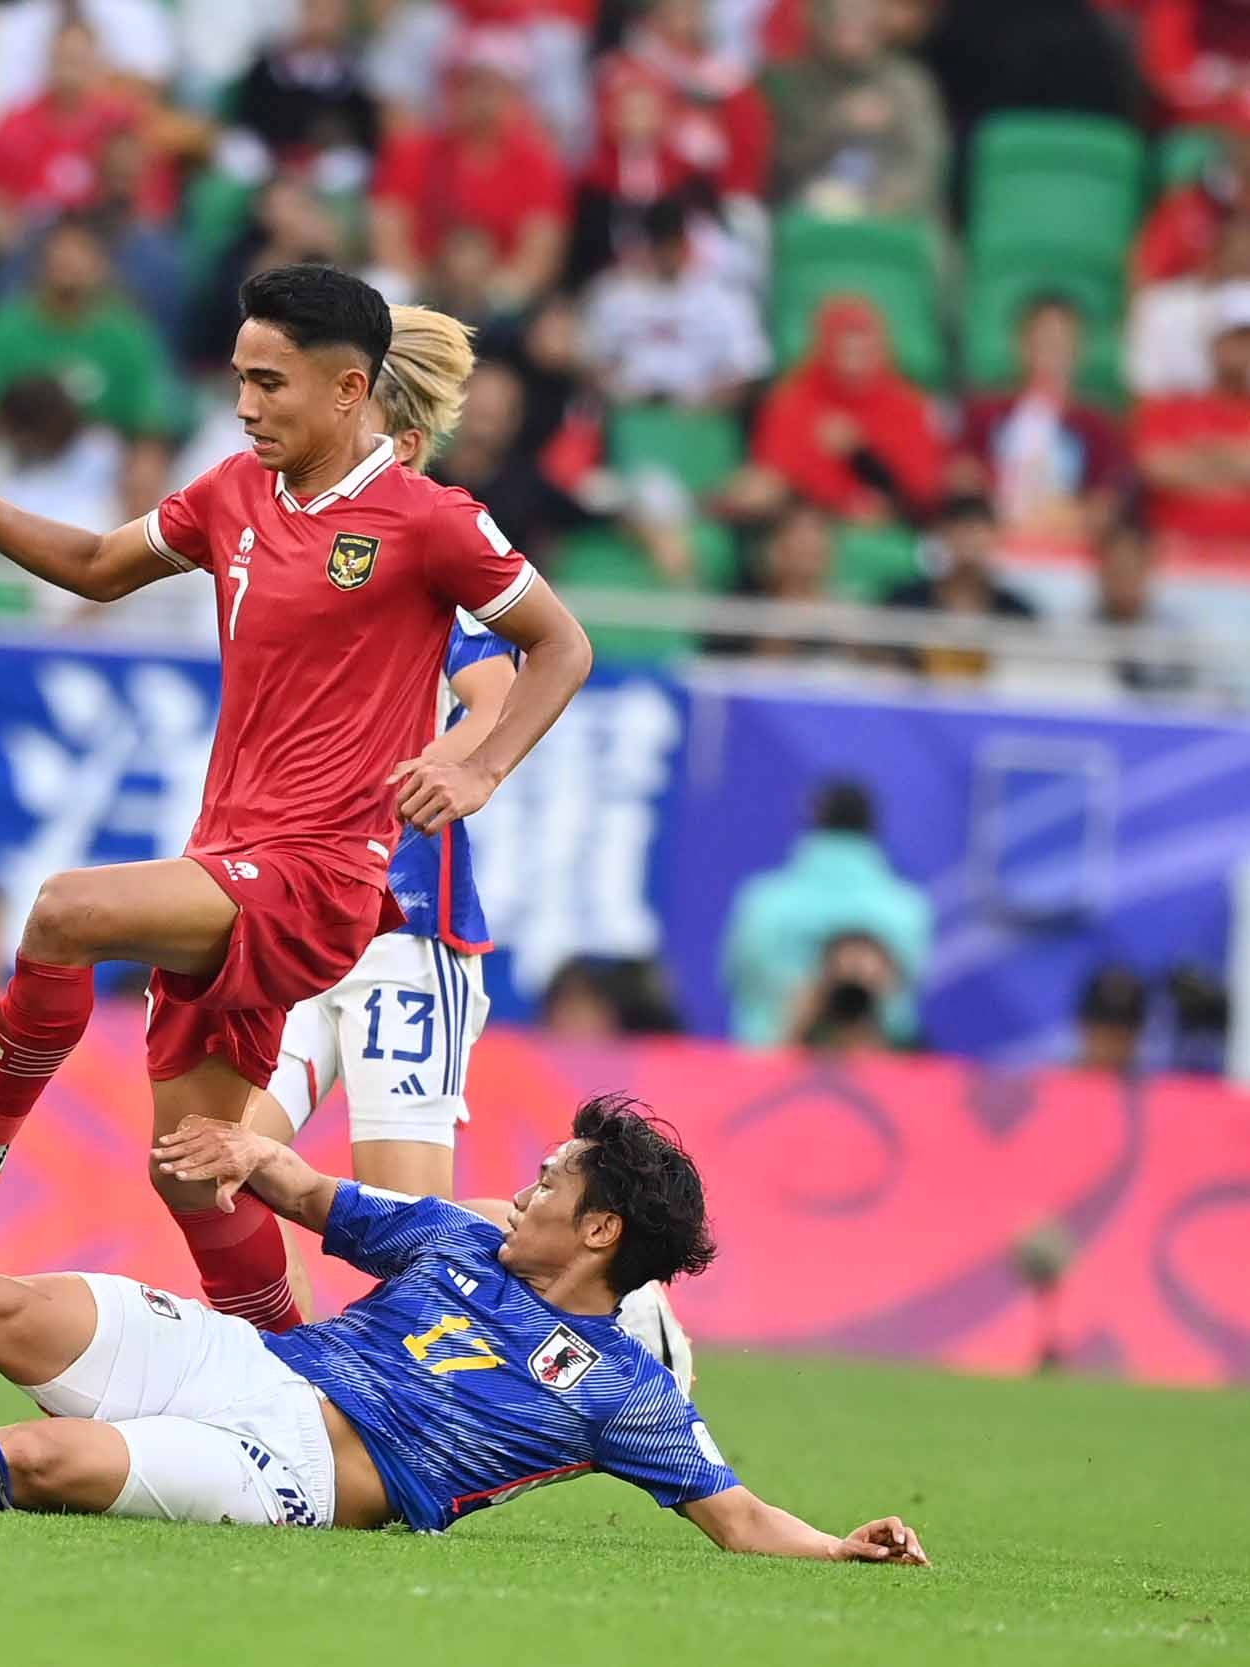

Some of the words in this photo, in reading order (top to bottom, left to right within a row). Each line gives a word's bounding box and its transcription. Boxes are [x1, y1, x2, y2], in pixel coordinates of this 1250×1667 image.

[228, 565, 249, 641] 7
[362, 988, 435, 1064] 13
[401, 1314, 508, 1376] 17
